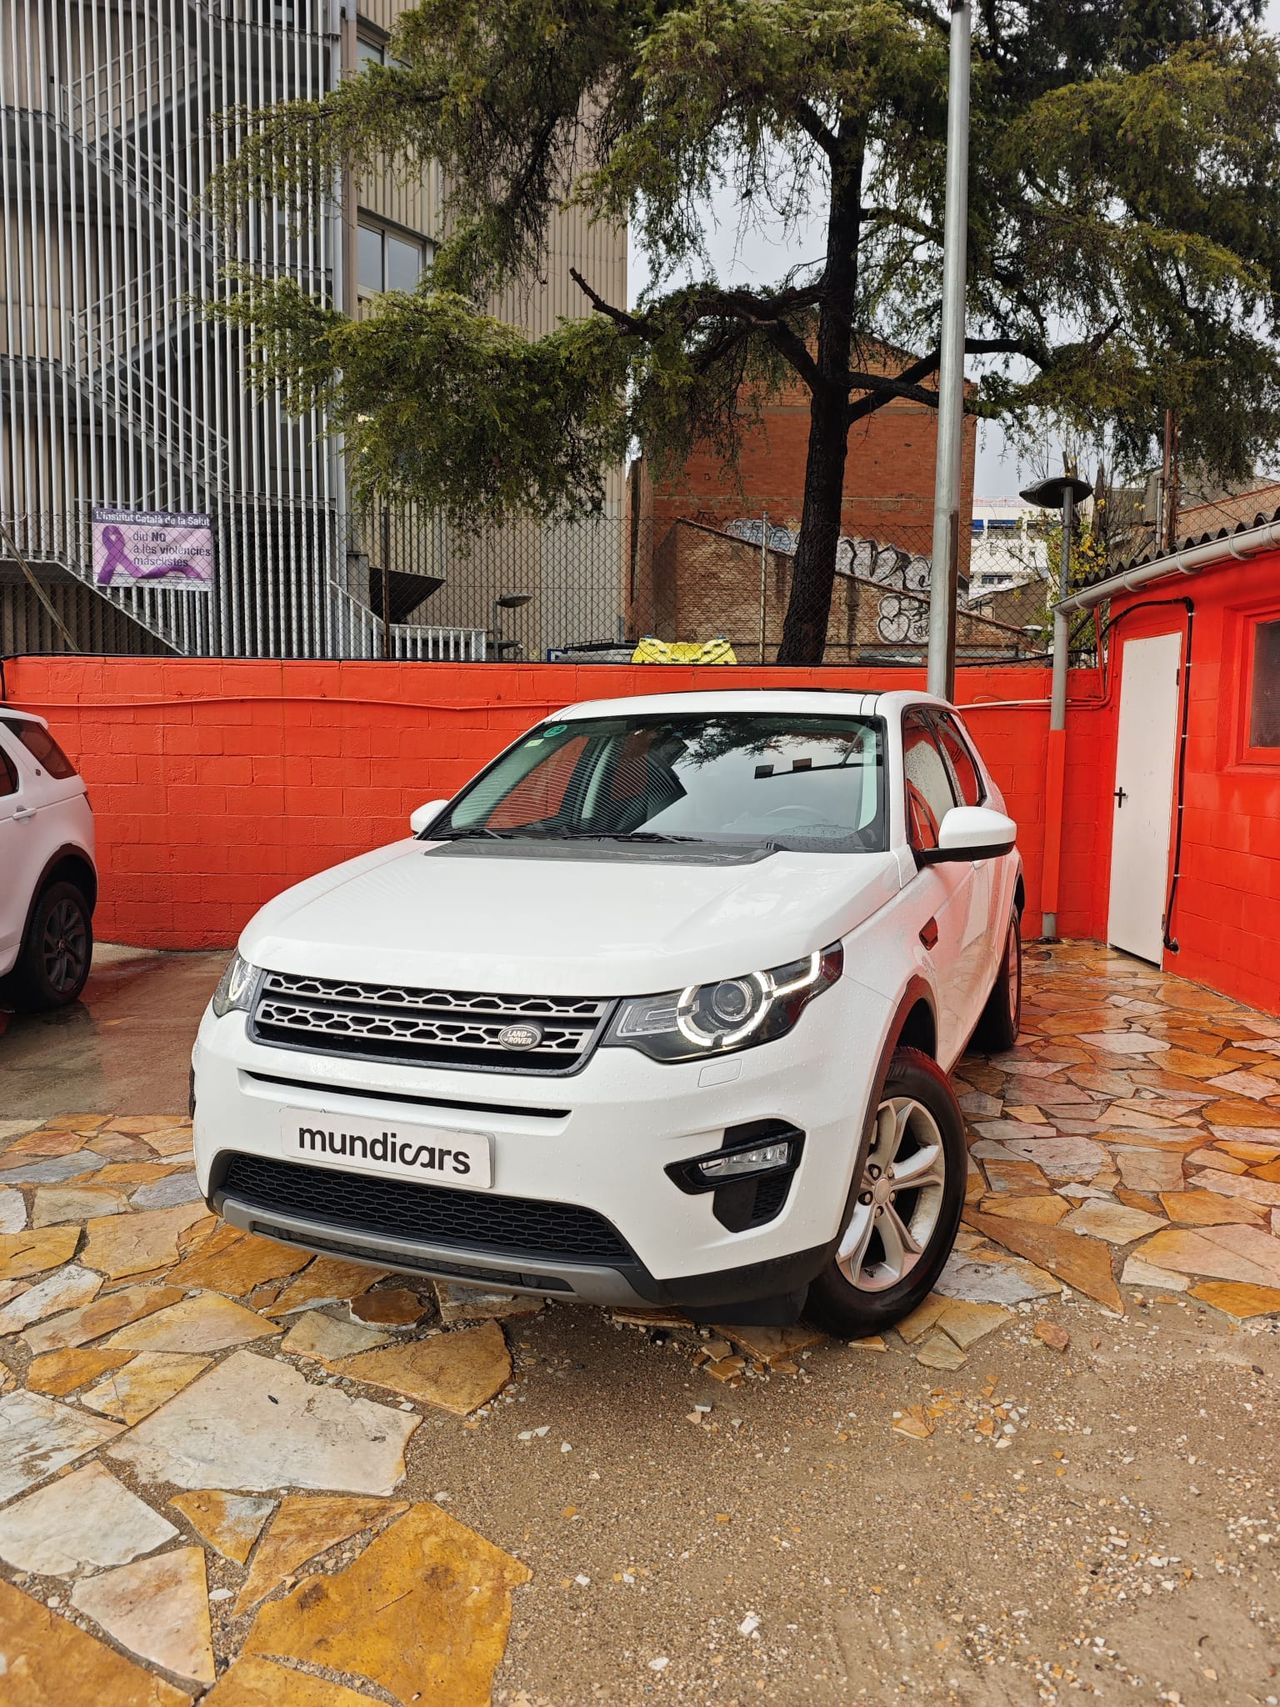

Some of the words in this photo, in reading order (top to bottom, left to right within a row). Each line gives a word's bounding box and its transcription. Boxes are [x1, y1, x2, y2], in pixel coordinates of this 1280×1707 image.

[135, 514, 163, 525] Català
[165, 515, 176, 525] de
[177, 516, 186, 525] la
[187, 516, 210, 527] Salut
[132, 531, 149, 541] diu
[151, 532, 166, 542] NO
[142, 544, 157, 554] les
[133, 556, 189, 567] masclistes
[298, 1127, 471, 1175] mundicars
